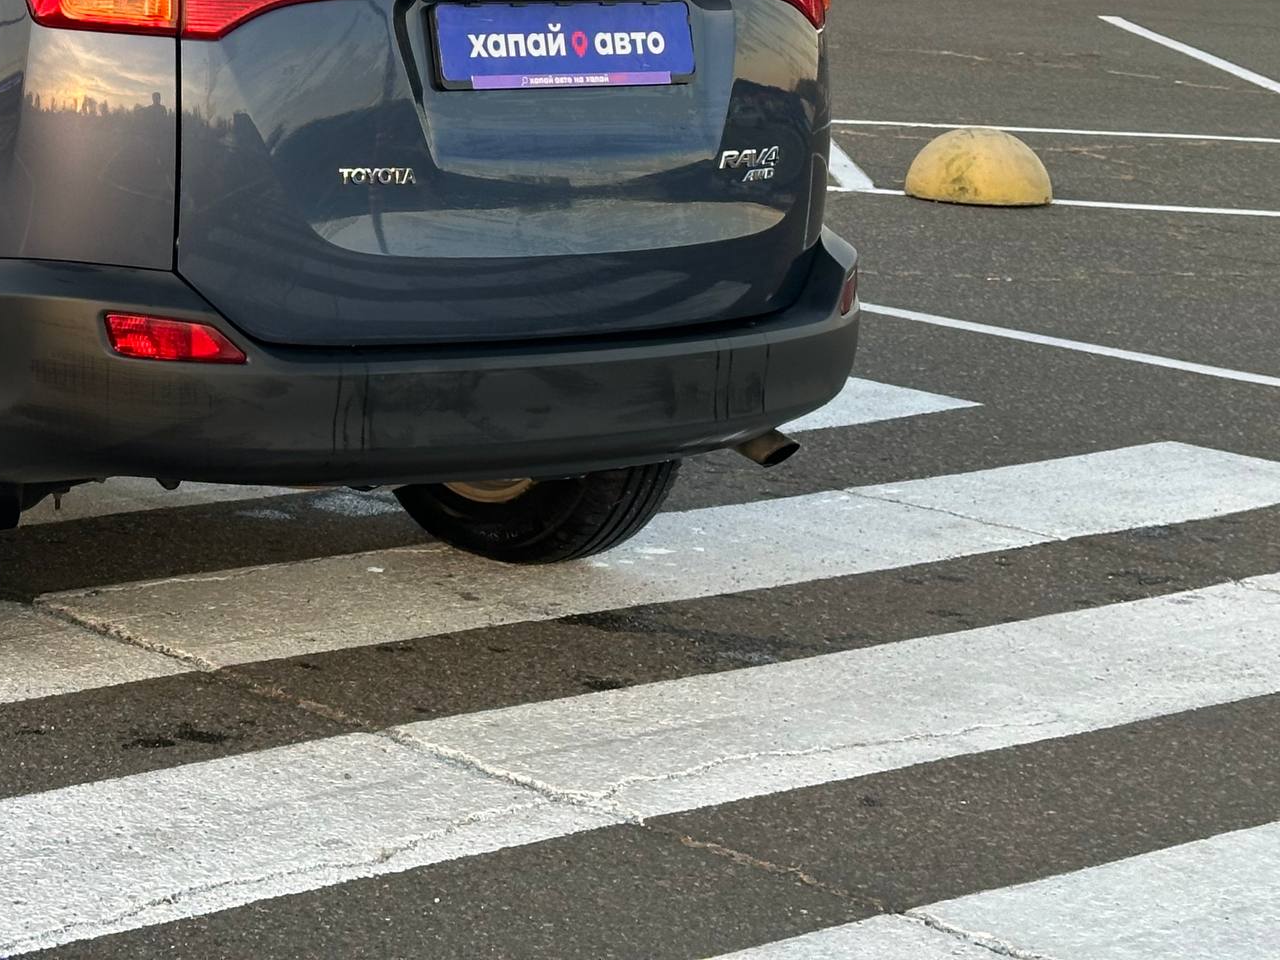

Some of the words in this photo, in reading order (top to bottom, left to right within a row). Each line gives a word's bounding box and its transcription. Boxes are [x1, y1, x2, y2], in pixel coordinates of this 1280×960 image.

[468, 23, 567, 58] хапай
[594, 31, 665, 56] авто
[719, 146, 780, 169] RAV4
[338, 167, 417, 184] TOYOTA
[742, 167, 775, 182] AWD
